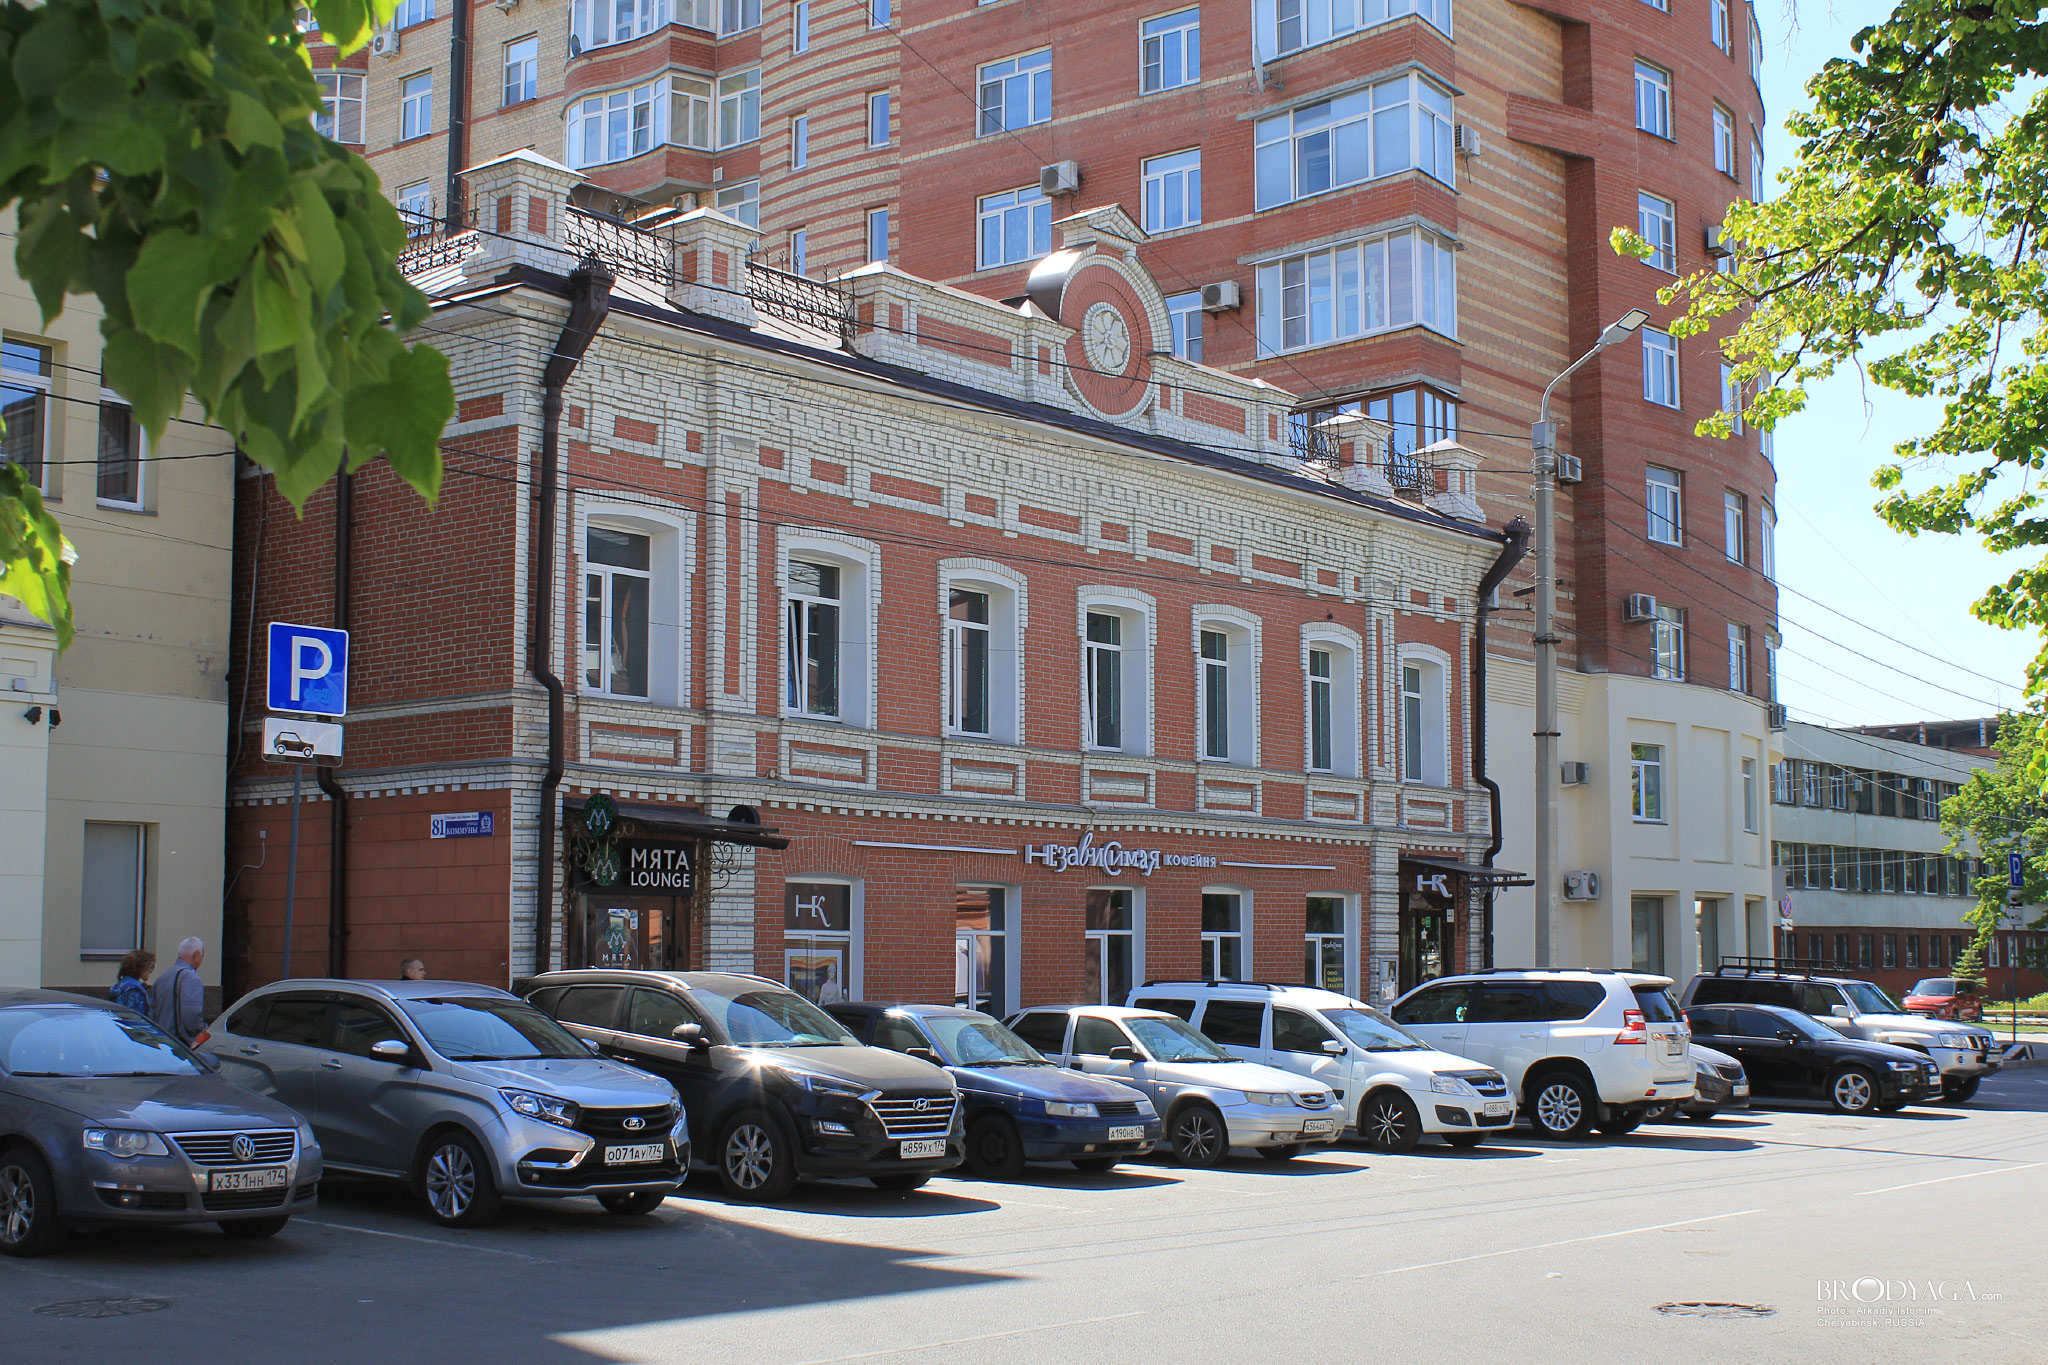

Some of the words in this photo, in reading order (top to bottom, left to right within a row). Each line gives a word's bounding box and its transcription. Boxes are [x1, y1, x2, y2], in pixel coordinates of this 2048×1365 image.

[291, 635, 333, 702] P
[432, 819, 444, 836] 81
[446, 826, 478, 835] КОММУНЫ
[631, 848, 690, 871] МЯТА
[2012, 857, 2021, 883] P
[630, 871, 691, 888] LOUNGE
[602, 953, 632, 961] МЯТА
[608, 1147, 646, 1161] О071АУ
[648, 1145, 662, 1156] 774
[903, 1142, 932, 1154] Н859УХ
[216, 1173, 264, 1190] Х331НН
[266, 1169, 285, 1182] 174
